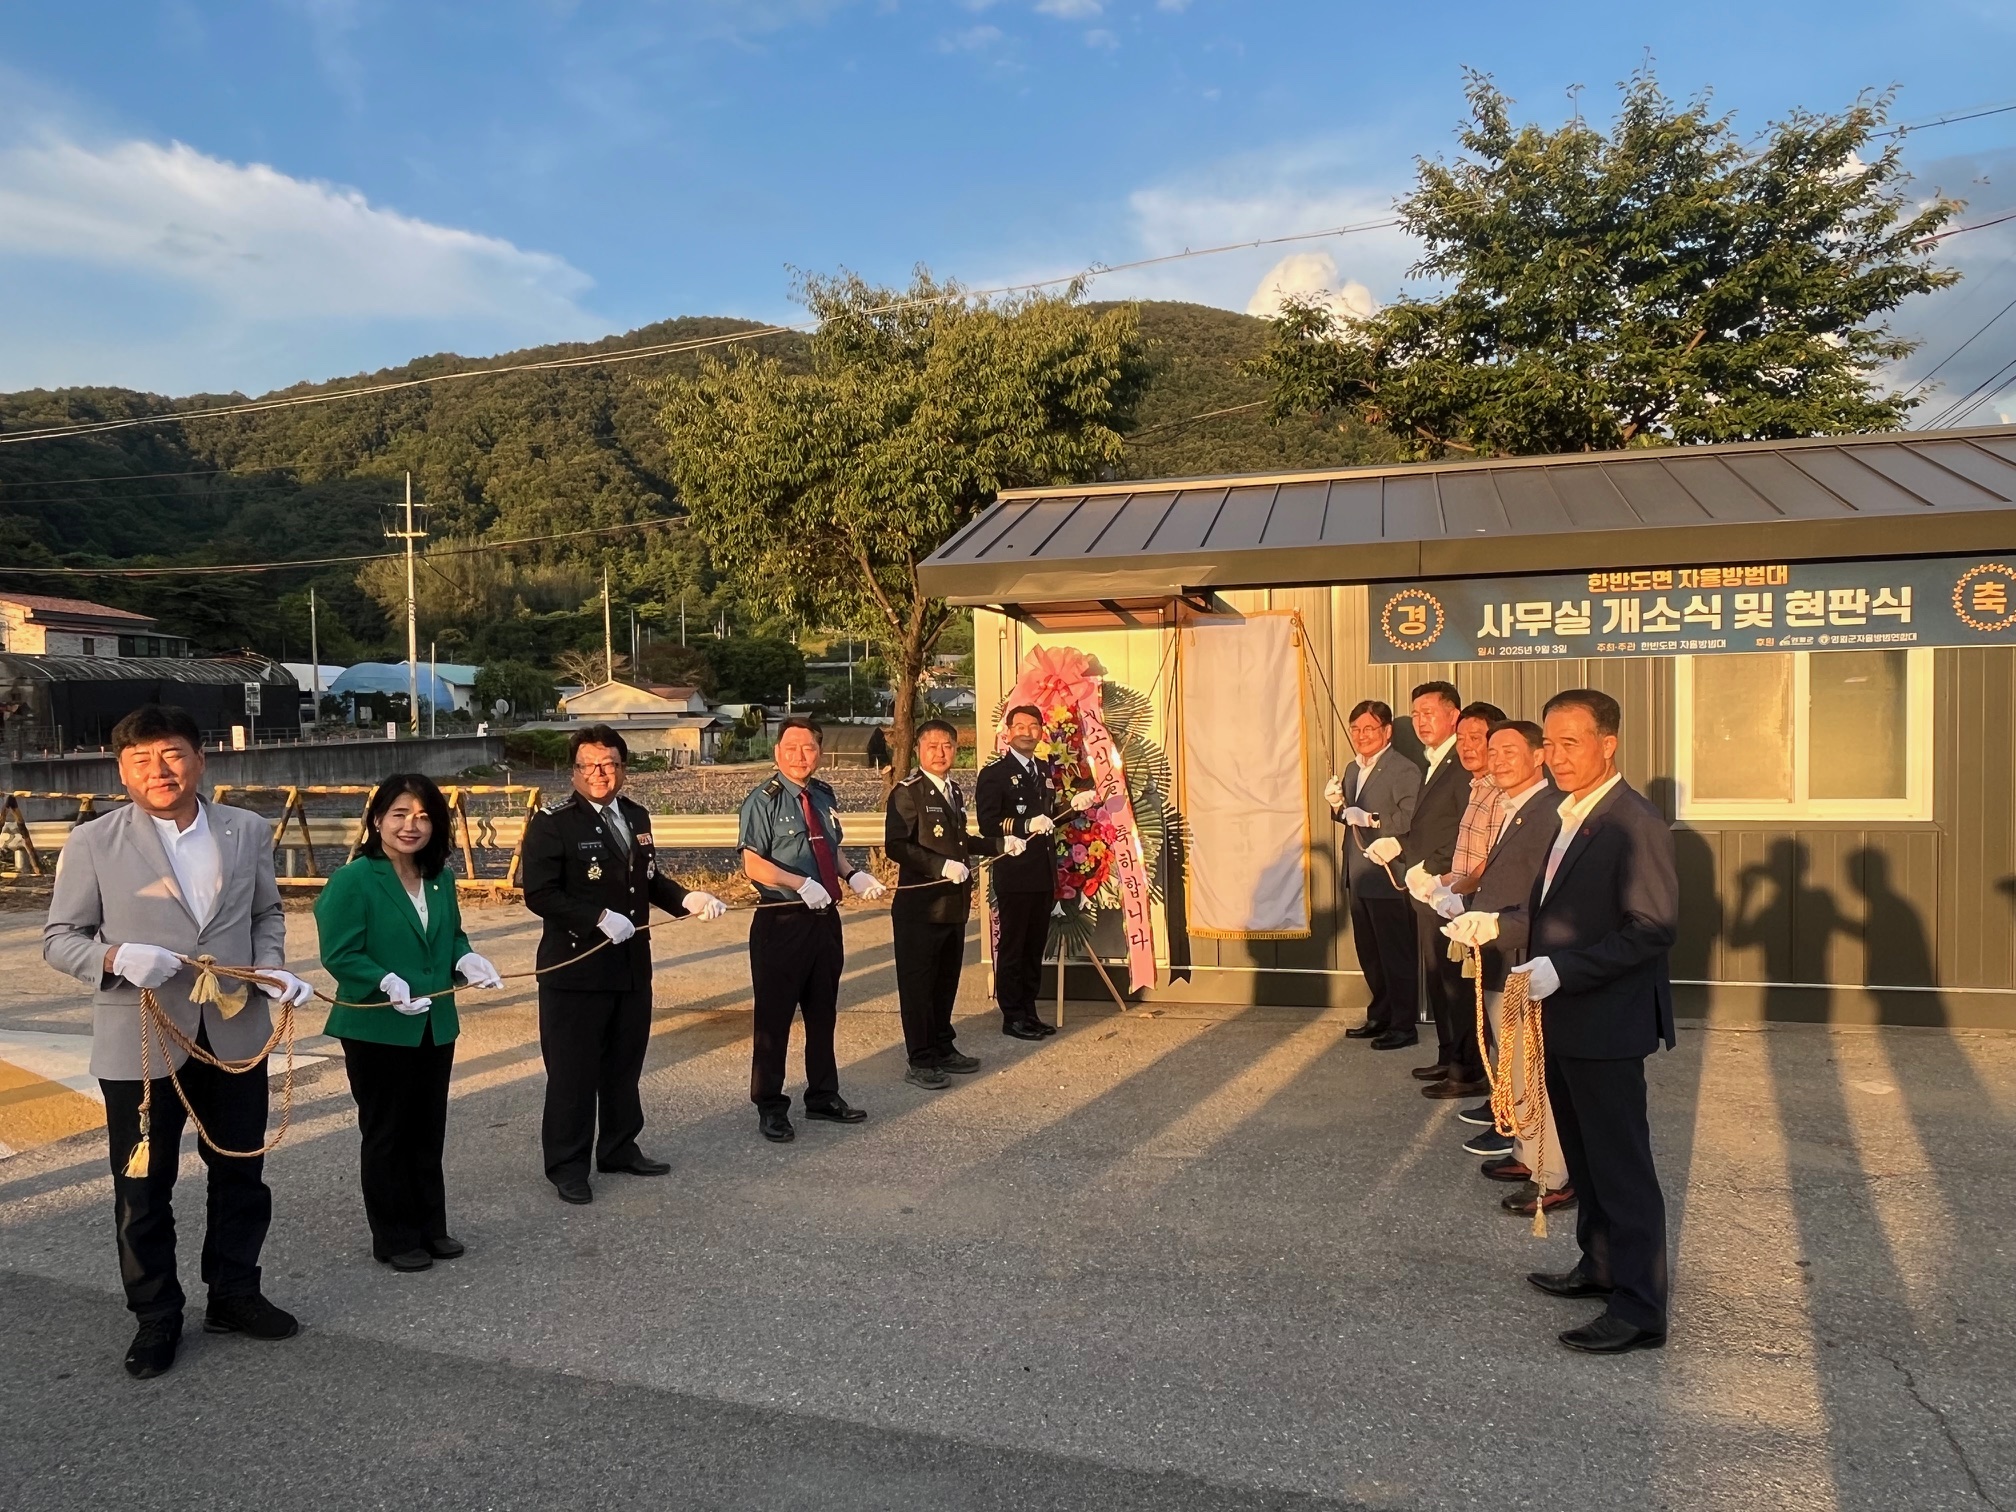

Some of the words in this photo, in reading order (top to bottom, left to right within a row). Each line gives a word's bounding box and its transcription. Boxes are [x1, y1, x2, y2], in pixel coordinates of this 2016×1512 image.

[1588, 570, 1673, 593] 한반도면
[1678, 565, 1788, 589] 자율방범대
[1477, 600, 1591, 638] 사무실
[1602, 594, 1722, 634] 개소식
[1734, 592, 1773, 630] 및
[1785, 586, 1912, 628] 현판식
[1973, 581, 2008, 614] 축
[1397, 604, 1427, 635] 경
[1477, 646, 1495, 656] 일시
[1499, 645, 1533, 656] 2025년
[1534, 645, 1550, 655] 9월
[1551, 644, 1567, 654] 3일
[1641, 640, 1678, 651] 한반도면
[1679, 639, 1727, 650] 자율방범대
[1116, 824, 1149, 951] 축하합니다
